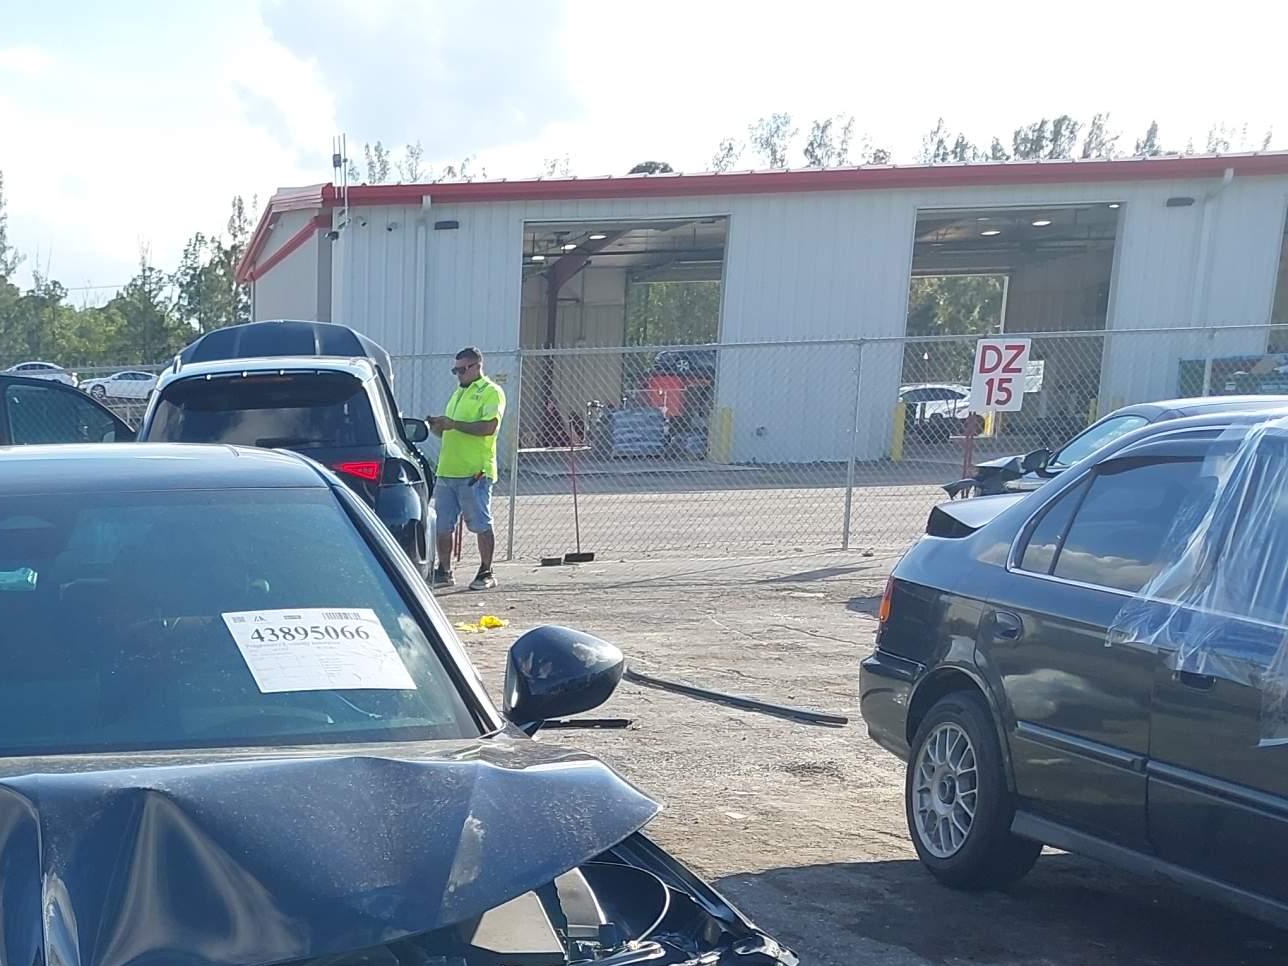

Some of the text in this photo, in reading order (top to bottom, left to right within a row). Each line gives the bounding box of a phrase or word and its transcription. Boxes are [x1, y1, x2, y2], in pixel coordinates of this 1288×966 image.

[979, 345, 1026, 374] DZ
[985, 378, 1013, 406] 15
[250, 624, 370, 643] 43895066
